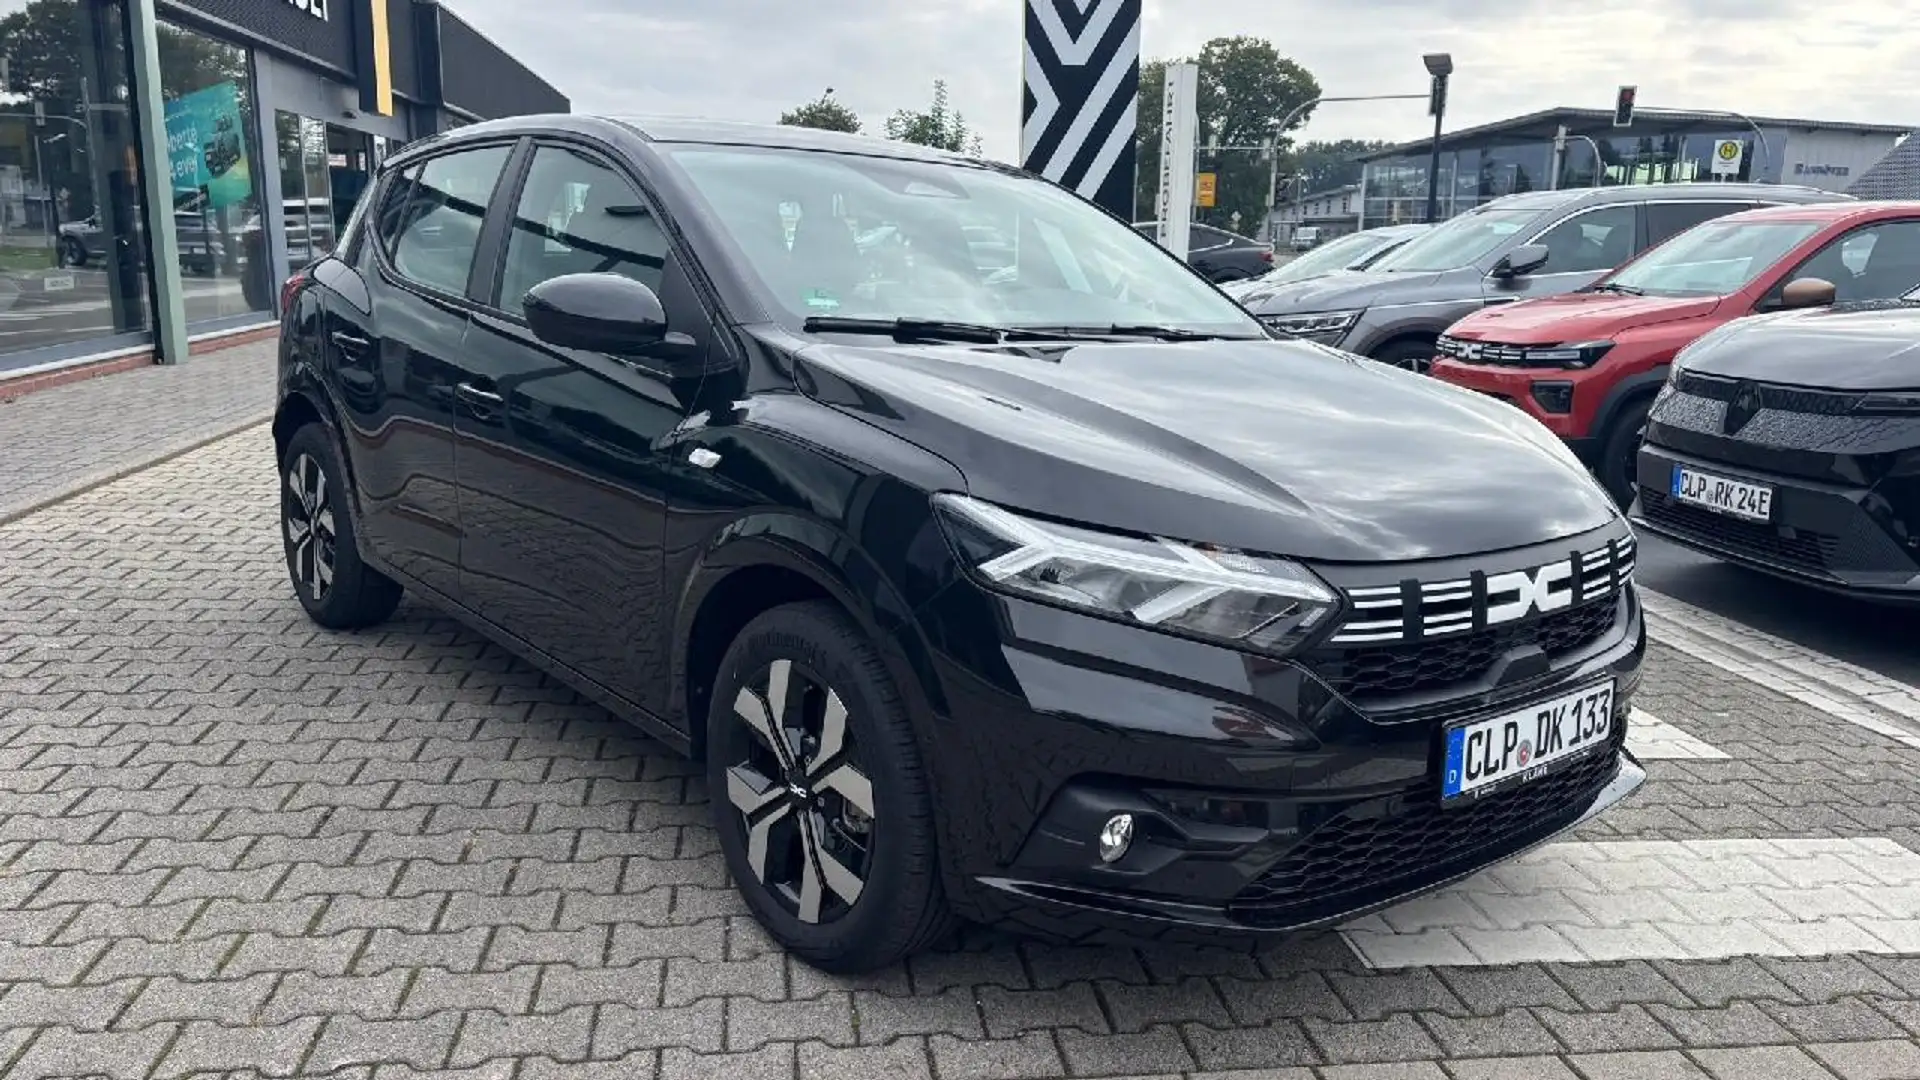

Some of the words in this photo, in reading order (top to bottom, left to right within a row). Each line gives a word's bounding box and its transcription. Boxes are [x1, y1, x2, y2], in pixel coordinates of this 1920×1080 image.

[1680, 472, 1707, 500] CLP
[1714, 481, 1735, 508] RK
[1738, 487, 1770, 516] 24E
[1465, 721, 1518, 781] CLP
[1534, 703, 1567, 759] DK
[1568, 688, 1611, 747] 133
